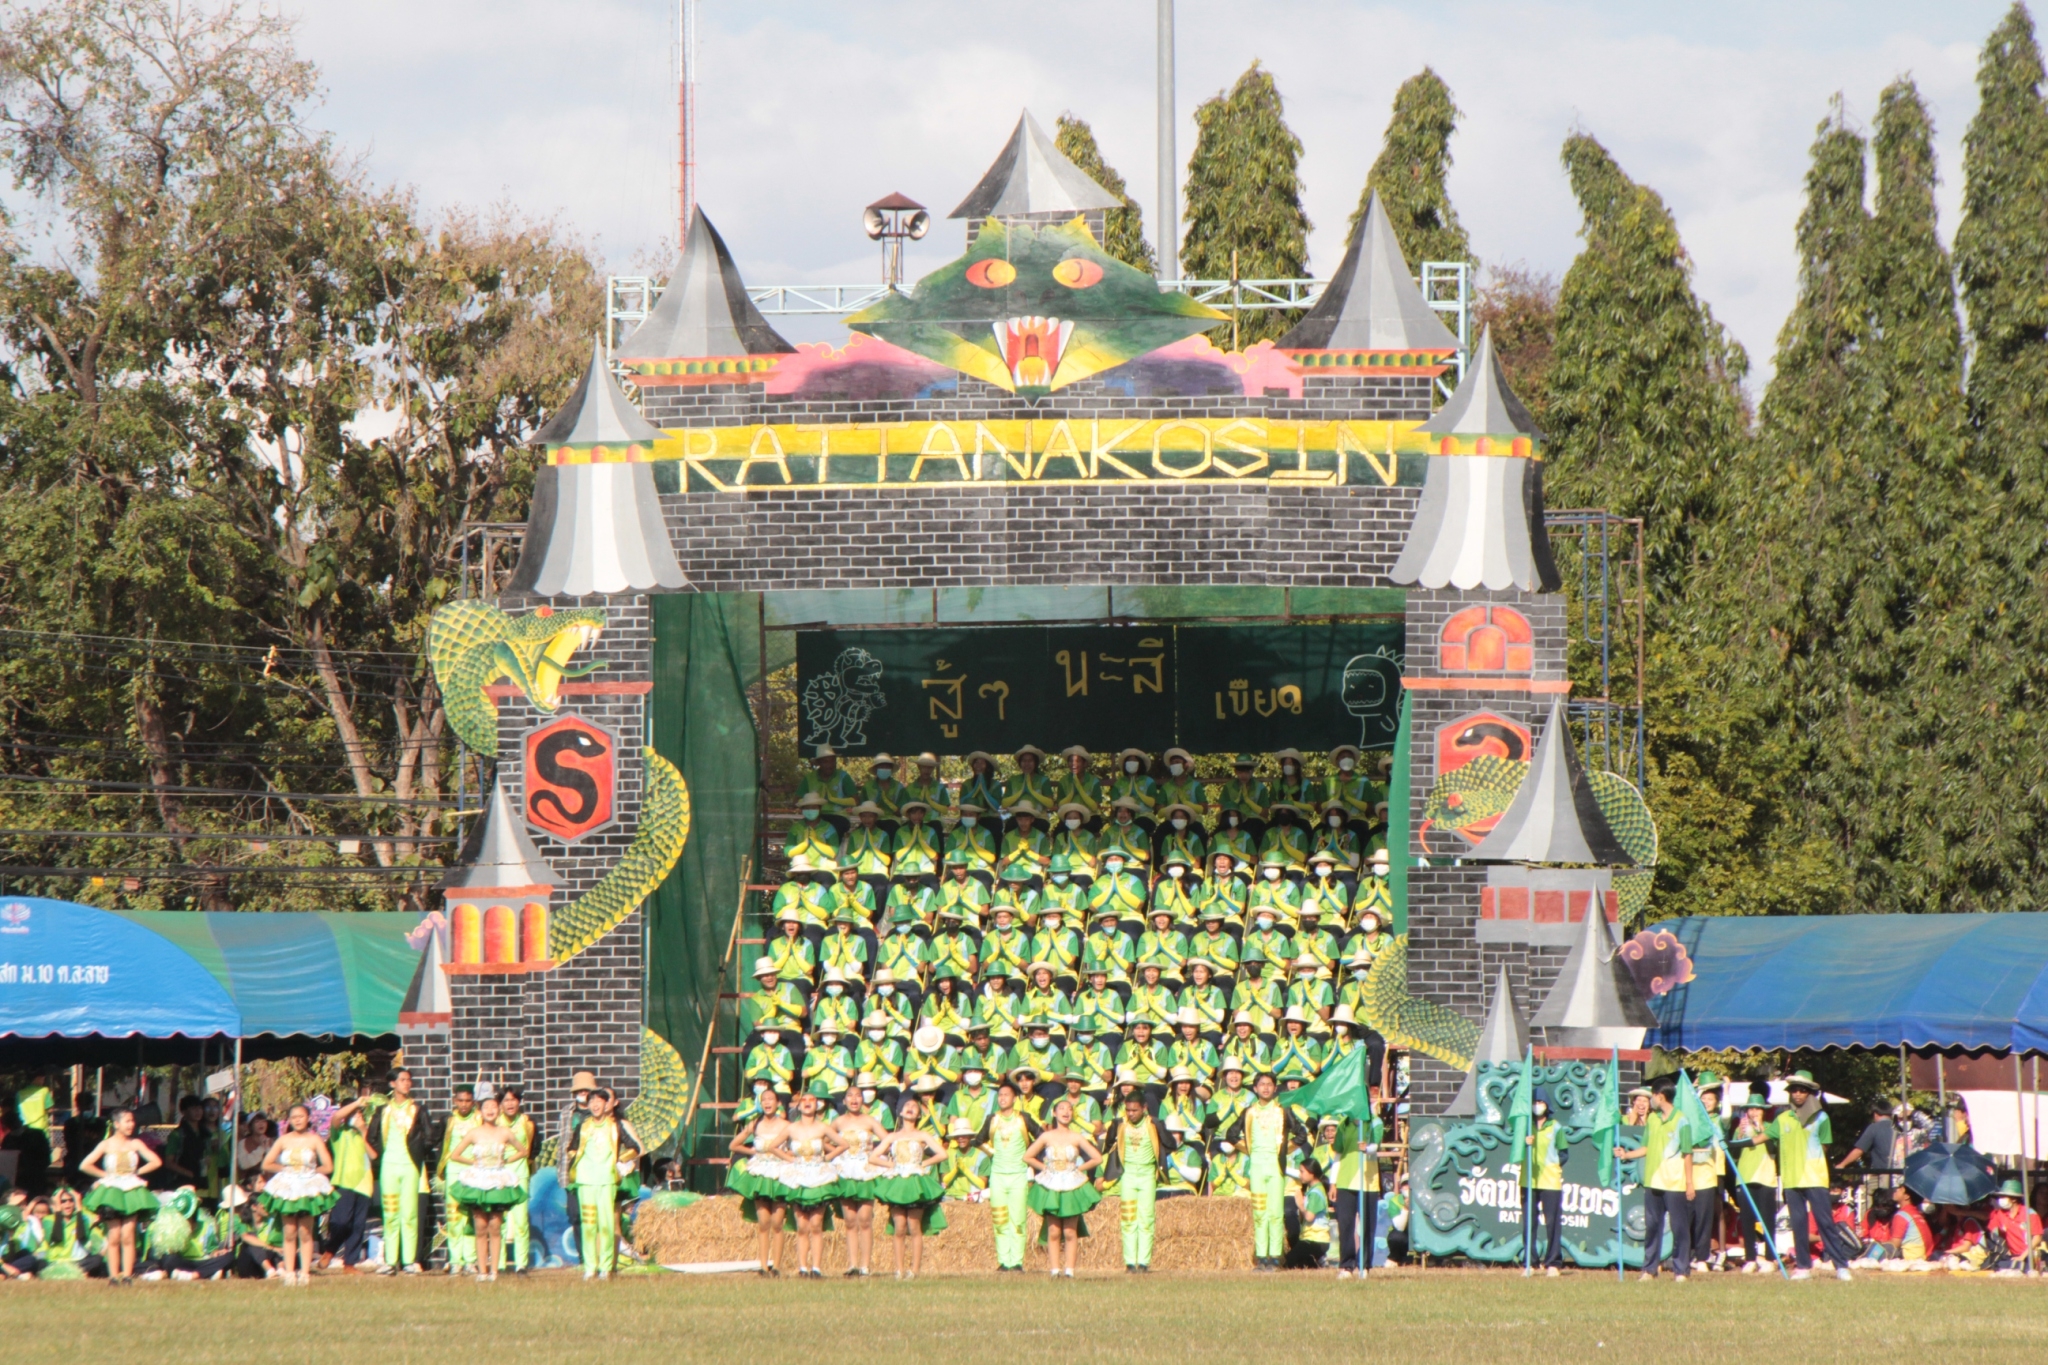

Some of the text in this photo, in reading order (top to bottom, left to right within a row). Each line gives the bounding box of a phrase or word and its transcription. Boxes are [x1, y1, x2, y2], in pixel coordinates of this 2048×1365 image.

[679, 420, 1398, 493] RATTANAKOSIN
[1458, 1163, 1637, 1218] รัตนโนทร์
